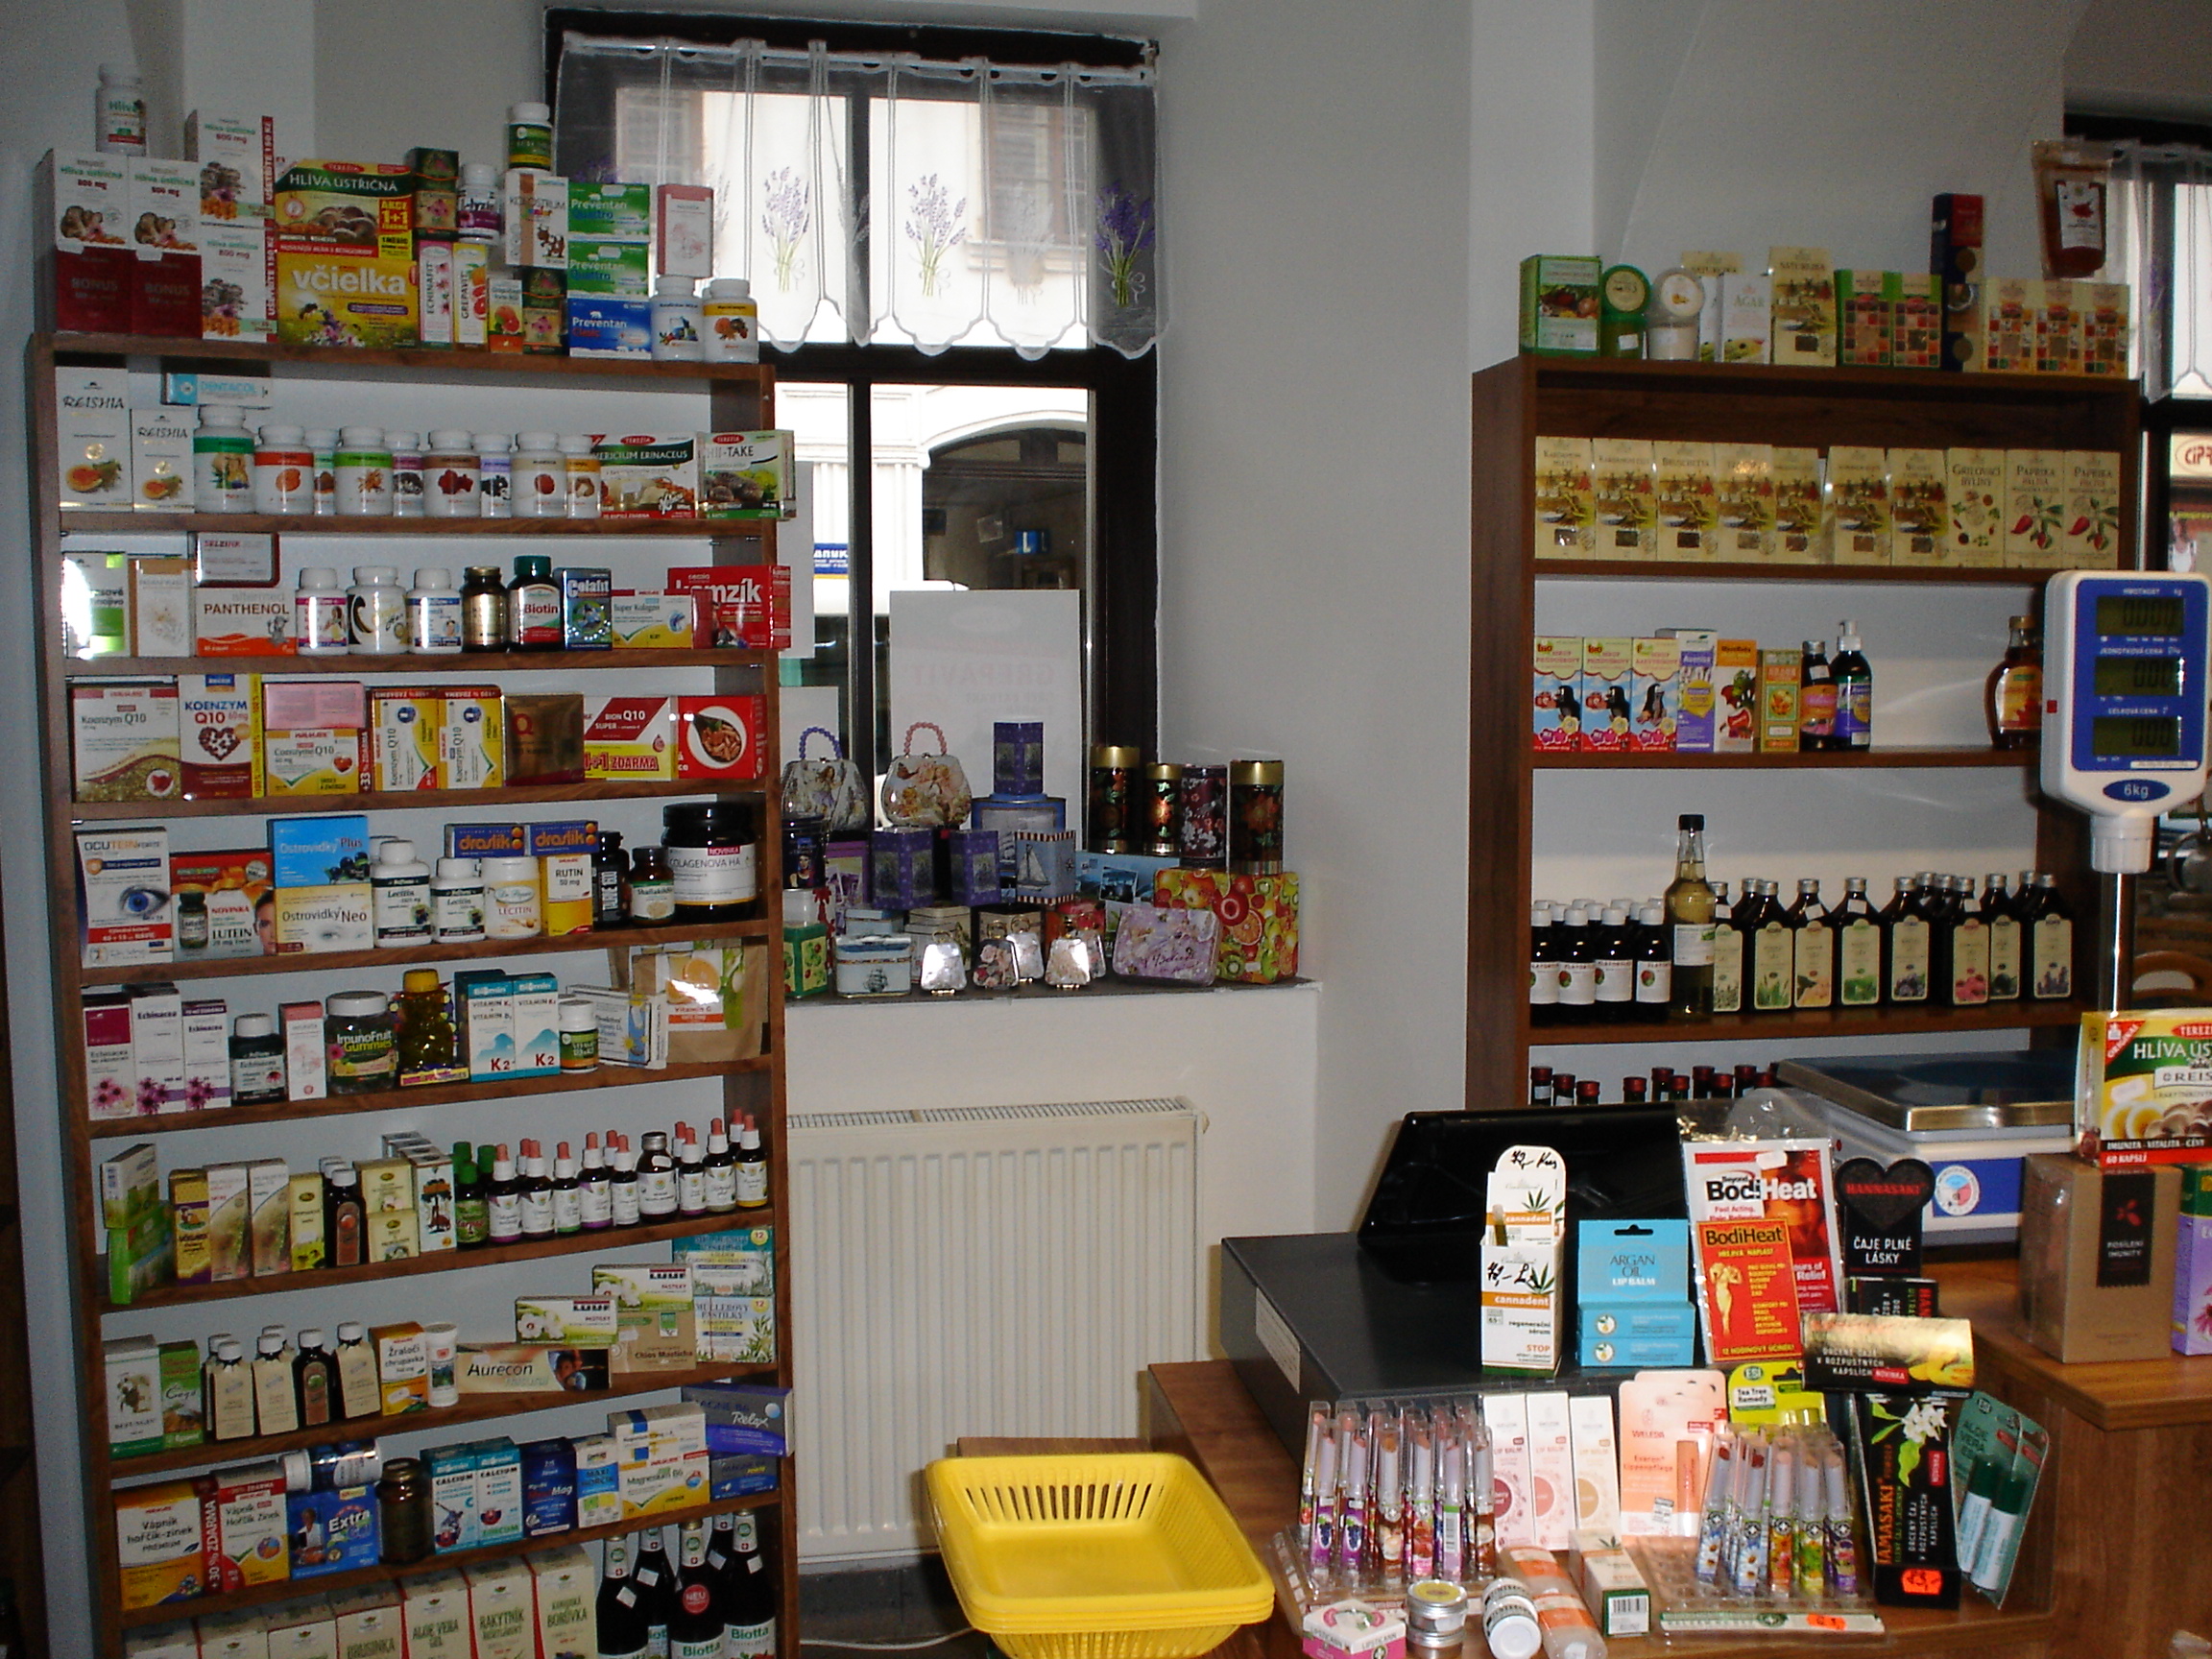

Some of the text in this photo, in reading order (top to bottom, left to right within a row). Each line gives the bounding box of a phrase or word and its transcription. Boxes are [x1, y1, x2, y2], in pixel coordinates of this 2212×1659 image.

[290, 174, 397, 192] HLÍVA ÚSTŘIČNÁ
[571, 199, 627, 211] Preventan
[381, 210, 408, 225] 1+1
[570, 257, 625, 270] Preventan
[292, 264, 406, 294] včielka
[572, 313, 627, 328] Preventan
[63, 397, 125, 409] REISHIA
[138, 427, 189, 439] REISHIA
[2017, 465, 2055, 477] PAPRIKA
[2075, 467, 2112, 479] PAPRIKA
[204, 604, 290, 614] PANTHENOL
[525, 604, 559, 615] Biotin
[185, 701, 247, 711] KOENZYM
[82, 711, 146, 726] Koenzym Q10
[195, 712, 225, 724] Q10
[623, 710, 645, 721] Q10
[388, 728, 397, 747] Q10
[453, 727, 463, 745] Q10
[315, 745, 334, 755] Q10
[360, 732, 370, 762] ZDARMA
[611, 755, 660, 771] ZDARMA
[2124, 782, 2149, 799] 6kg
[341, 837, 362, 849] Plus
[556, 868, 584, 878] RUTIN
[282, 907, 368, 923] Ostrovidky Neo
[212, 927, 252, 939] LUTEIN
[137, 1010, 177, 1020] Echinacea
[188, 1024, 223, 1033] Echinacea
[336, 1030, 392, 1044] ImunoFruit
[344, 1040, 392, 1052] Gummies
[2133, 1040, 2187, 1060] HLÍVA
[2106, 1141, 2142, 1150] IMUNITA
[2147, 1140, 2180, 1149] VITALITA
[2117, 1152, 2148, 1164] KAPSLÍ
[1706, 1177, 1817, 1202] BodiHeat
[1505, 1214, 1552, 1224] cannadent
[1705, 1227, 1784, 1246] BodiHeat
[1853, 1235, 1911, 1250] ČAJE PLNÉ
[1610, 1254, 1656, 1266] ARGAN
[1865, 1250, 1899, 1264] LÁSKY
[1623, 1266, 1643, 1279] OIL
[1494, 1295, 1550, 1306] cannadent
[635, 1349, 693, 1359] Chios Masticha
[1527, 1343, 1551, 1353] STOP
[468, 1362, 533, 1378] Aurecon
[1833, 1365, 1906, 1381] KAPSLÍCH NOVINKA
[1738, 1395, 1767, 1405] Remedy
[731, 1410, 769, 1428] Relax
[1631, 1431, 1666, 1439] WELEDA
[480, 1466, 517, 1479] CALCIUM
[436, 1473, 473, 1485] CALCIUM
[204, 1500, 219, 1552] ZDARMA
[328, 1509, 371, 1534] Extra
[685, 1592, 707, 1601] NEU
[732, 1625, 770, 1640] Biotta
[683, 1641, 722, 1657] Biotta
